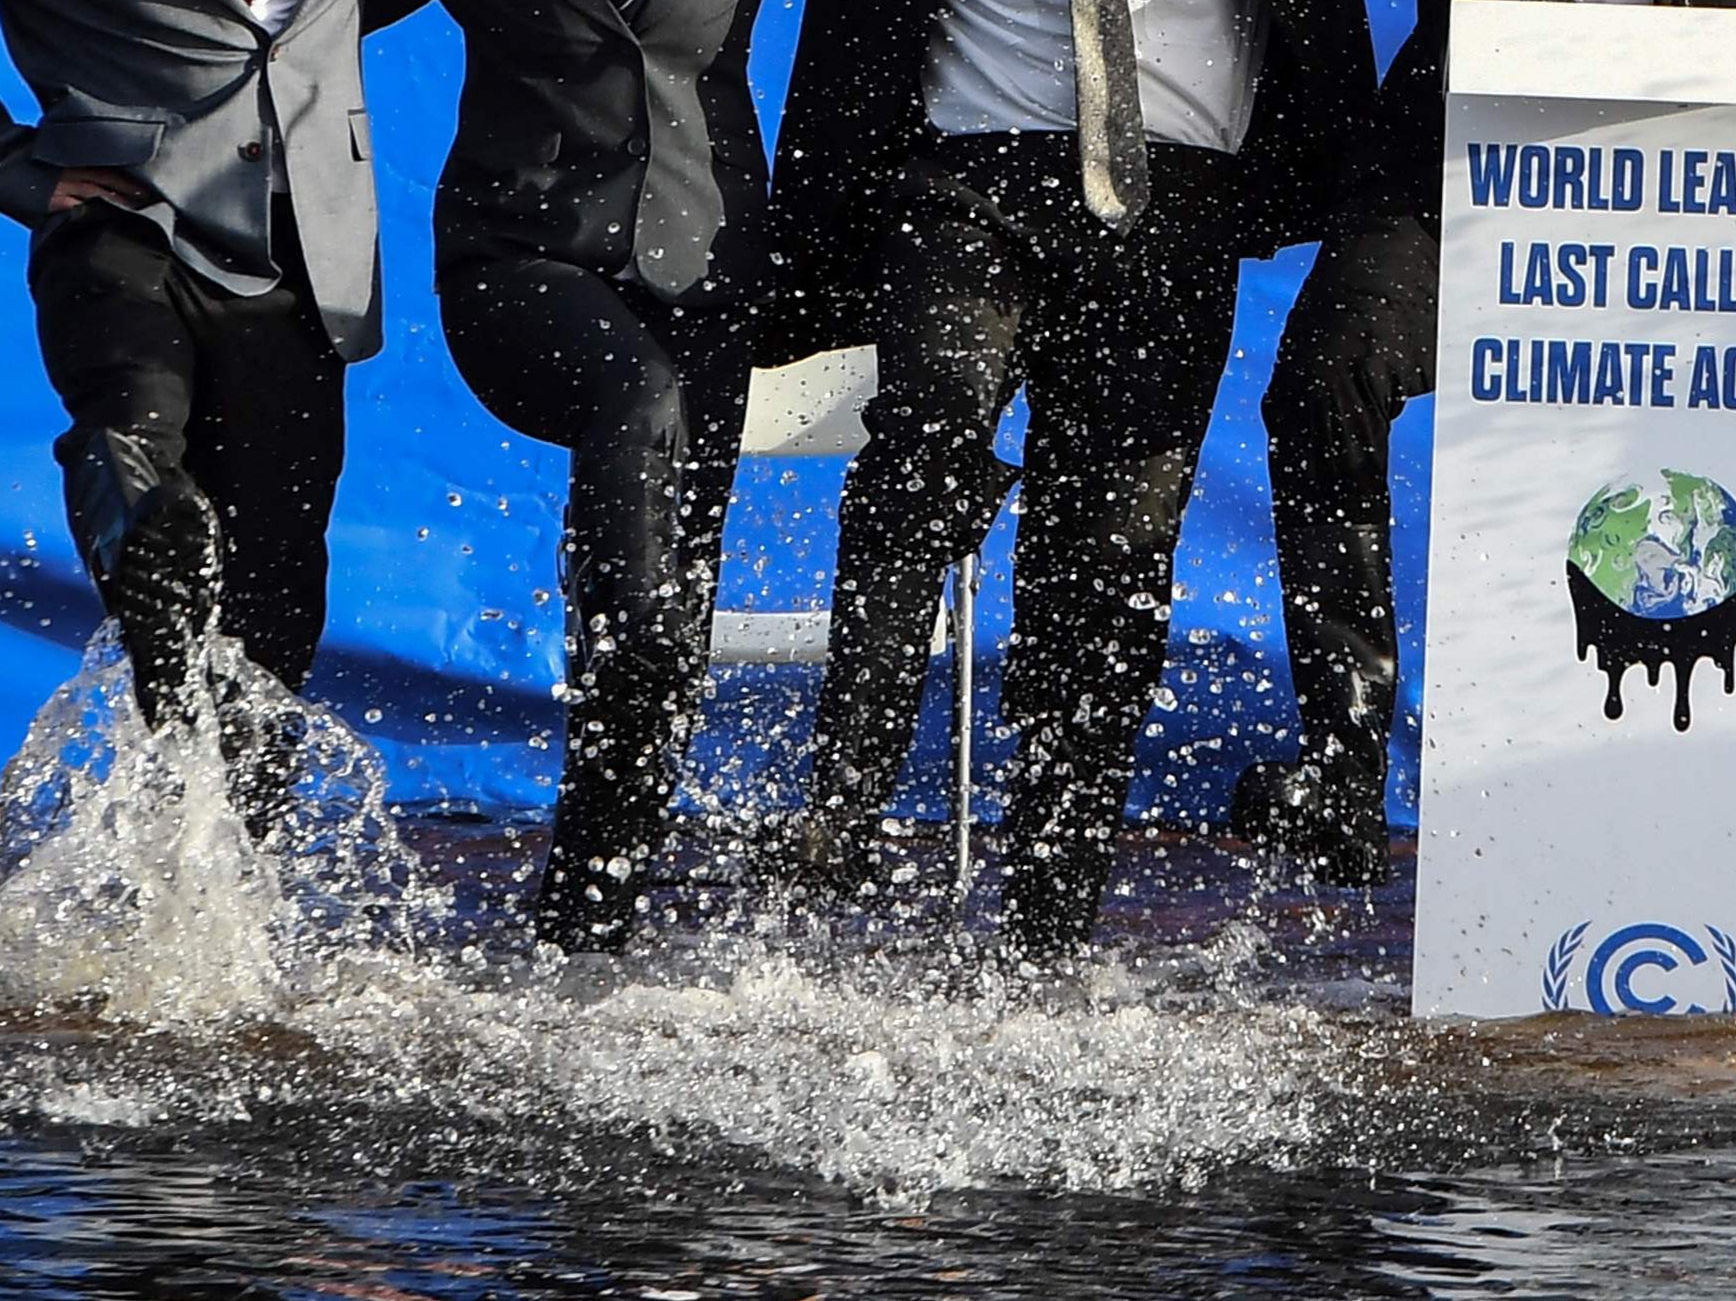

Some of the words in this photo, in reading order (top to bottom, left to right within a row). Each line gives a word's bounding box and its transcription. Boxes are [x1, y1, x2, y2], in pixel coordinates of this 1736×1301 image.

[1467, 142, 1644, 212] WORLD
[1498, 241, 1615, 308] LAST
[1471, 337, 1676, 408] CLIMATE
